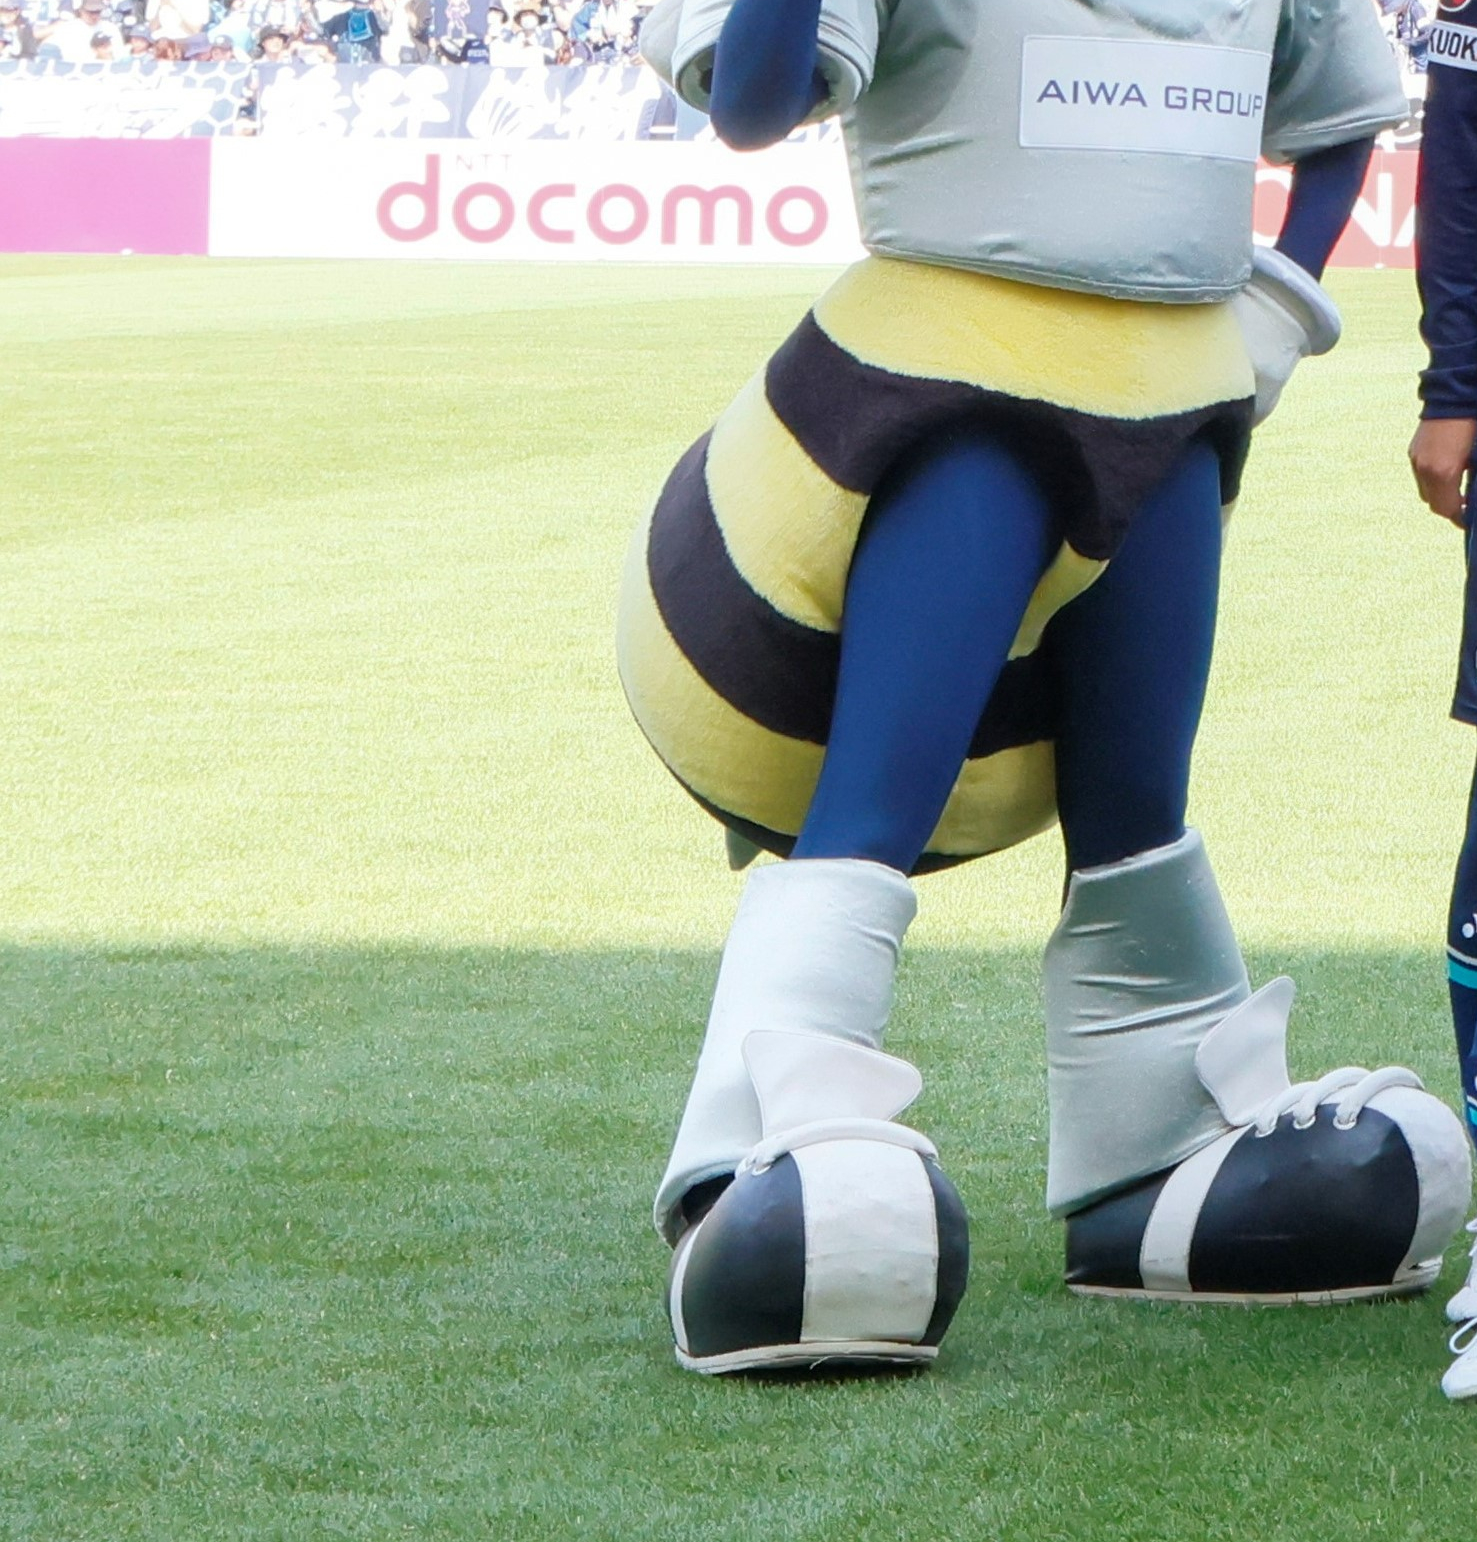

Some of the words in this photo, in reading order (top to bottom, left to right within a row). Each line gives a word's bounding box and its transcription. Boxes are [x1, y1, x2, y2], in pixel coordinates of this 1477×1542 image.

[1036, 79, 1148, 109] AIWA
[1163, 85, 1264, 118] GROUP
[375, 153, 830, 247] docomo
